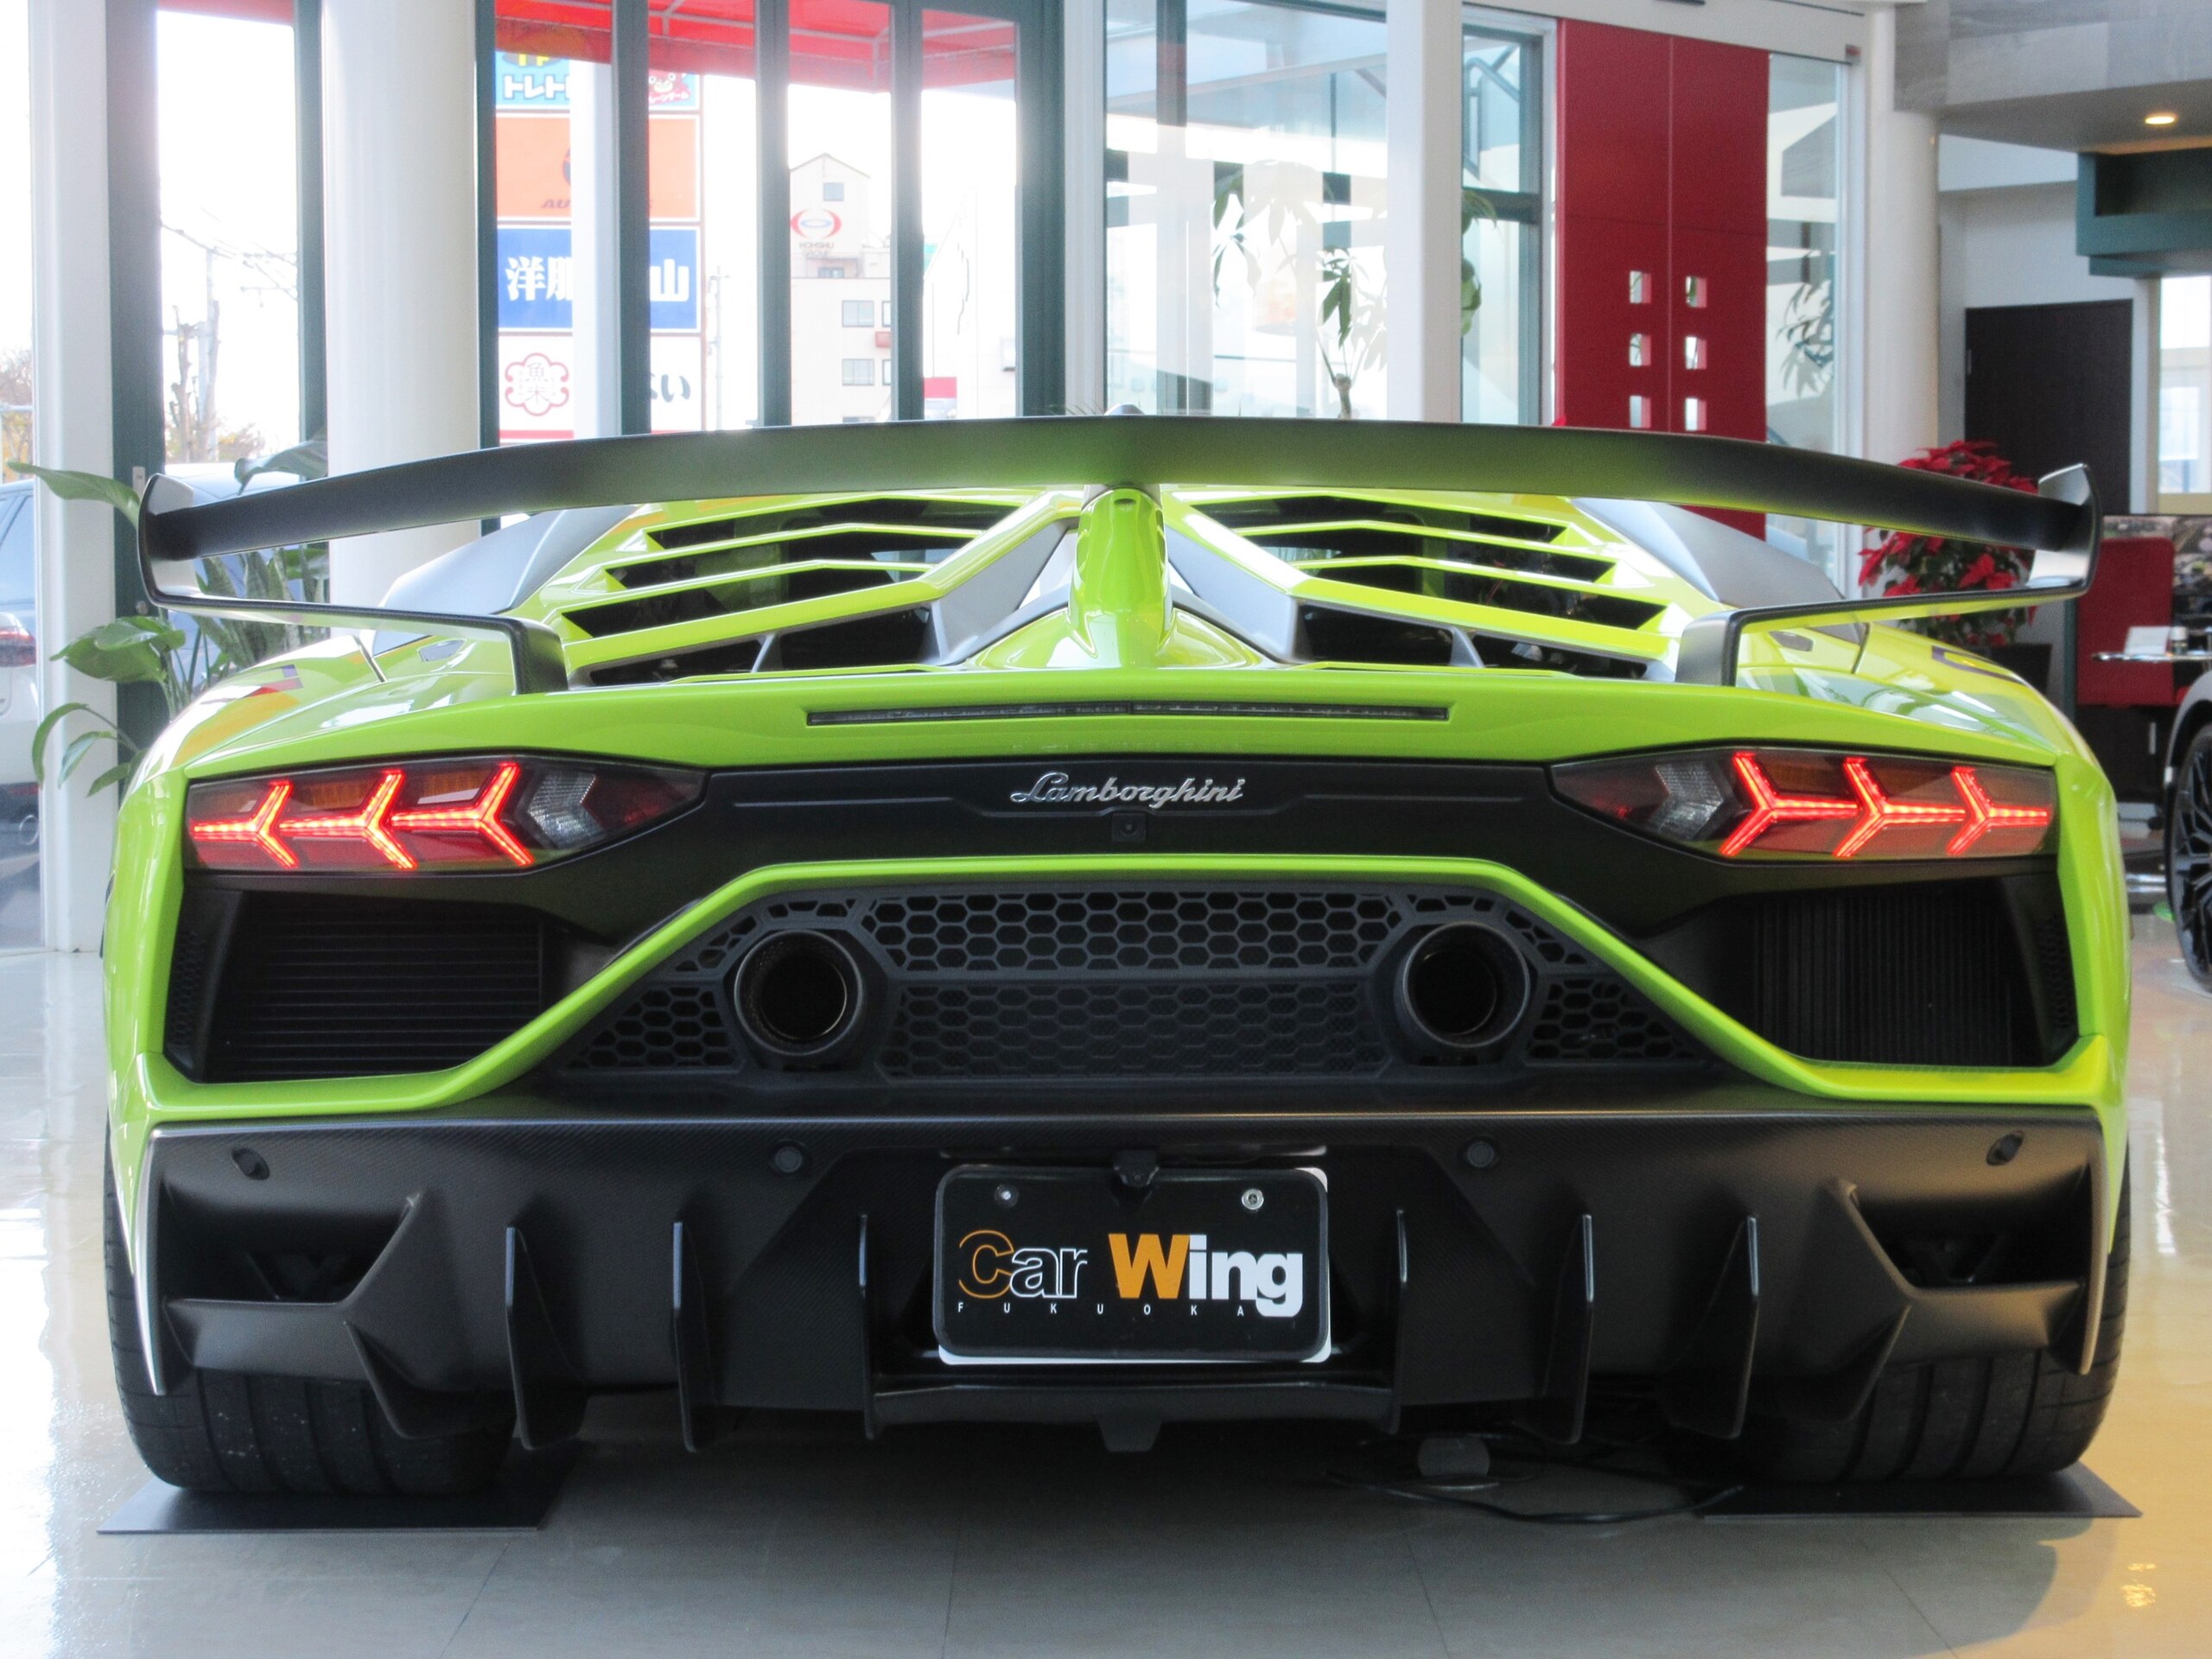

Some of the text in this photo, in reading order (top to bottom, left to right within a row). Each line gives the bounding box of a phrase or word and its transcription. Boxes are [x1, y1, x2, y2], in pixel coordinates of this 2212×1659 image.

[1010, 771, 1246, 810] Lamborghini
[958, 1229, 1303, 1318] Car Wing
[957, 1302, 1244, 1318] FUKUOKA
